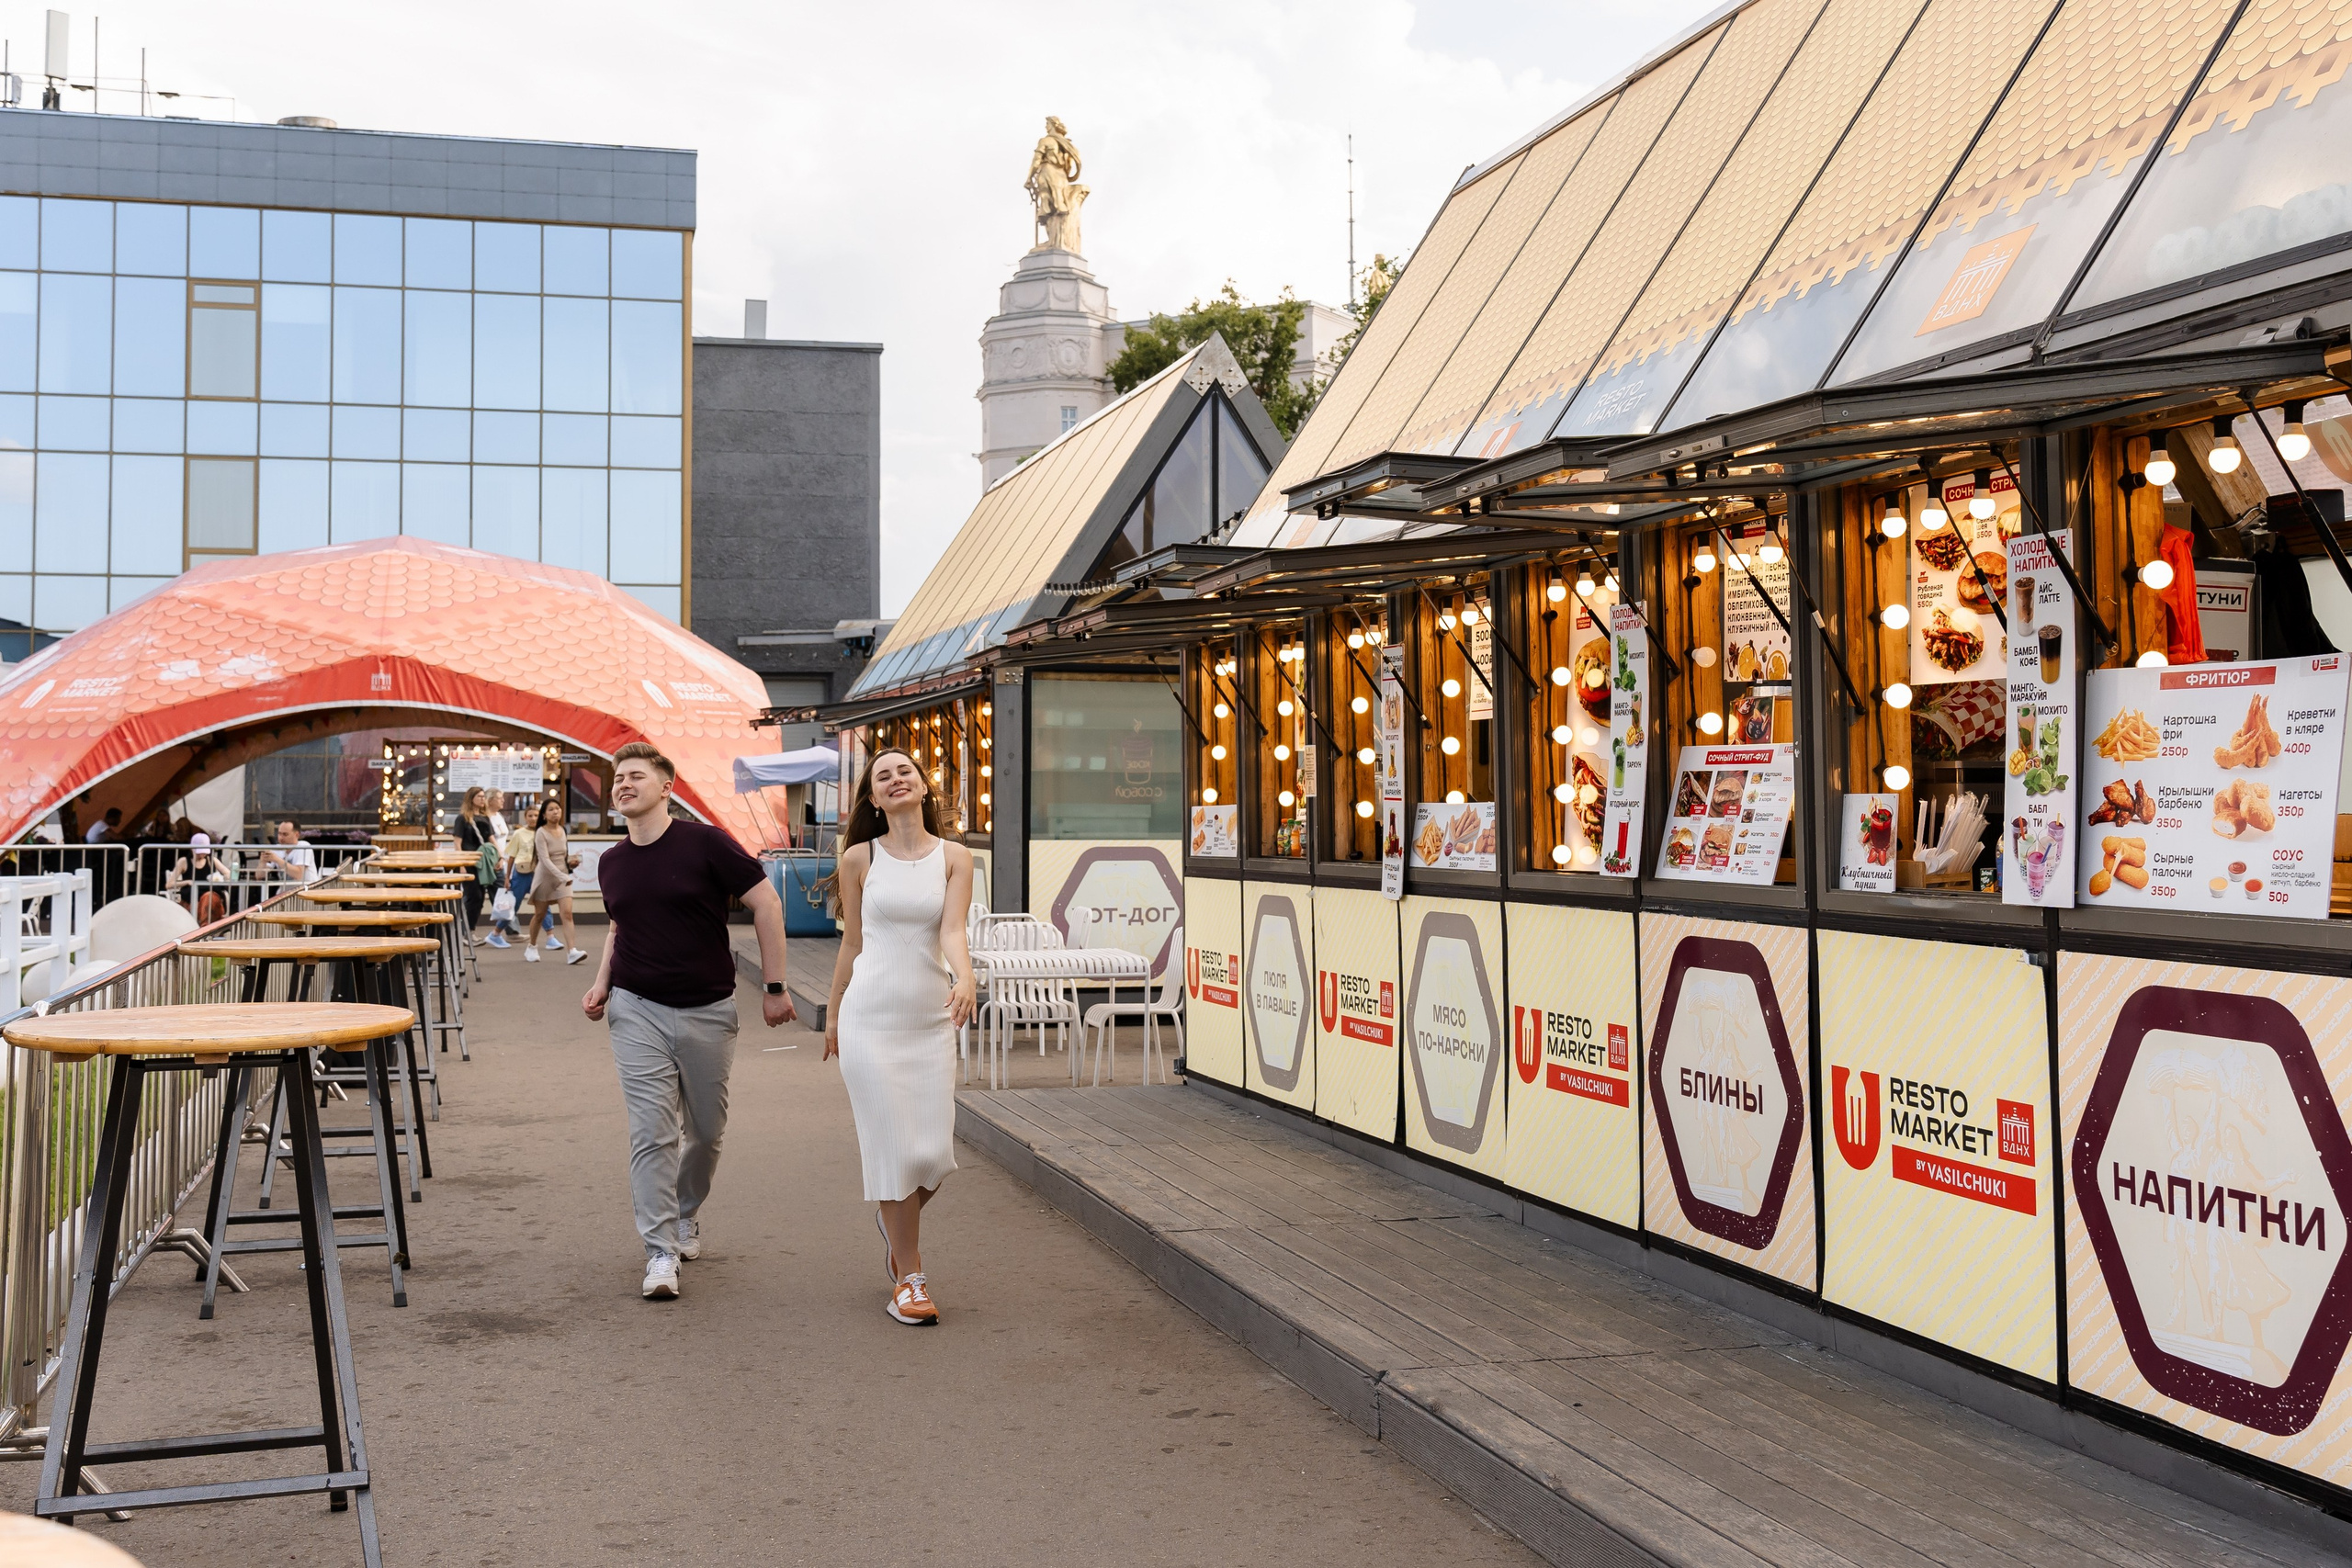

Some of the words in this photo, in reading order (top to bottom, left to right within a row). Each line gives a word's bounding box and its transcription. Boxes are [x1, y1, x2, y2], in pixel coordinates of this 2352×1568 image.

[1931, 290, 1987, 322] ВДНХ
[1593, 379, 1645, 410] RESTO
[1581, 393, 1646, 428] MARKET
[1949, 485, 1974, 500] СОЧН
[2010, 535, 2067, 558] ХОЛОДЕ
[1765, 561, 1790, 571] ЛЕСНЫ
[2014, 554, 2059, 573] НАПИТК
[2039, 581, 2053, 594] АЙС
[1775, 595, 1789, 606] ЧАЙ
[2038, 592, 2061, 604] ЛАТТЕ
[2197, 592, 2242, 605] ТУНИ
[1614, 619, 1642, 631] НАПИТКИ
[1771, 621, 1786, 631] ПУН
[2014, 646, 2038, 657] БАМБЛ
[2019, 657, 2038, 667] КОФЕ
[69, 677, 119, 688] RESTO
[2185, 671, 2251, 685] ФРИТЮР
[59, 686, 123, 698] MARKET
[668, 681, 715, 693] RESTO
[2010, 682, 2037, 694] МАНГО-
[676, 691, 732, 703] MARKET
[2010, 690, 2048, 703] МАРАКУЙЯ
[2038, 705, 2068, 716] МОХИТО
[2287, 707, 2336, 721] Креветки
[2163, 715, 2217, 726] Картошка
[2162, 728, 2183, 741] фри
[2286, 727, 2291, 735] в
[2294, 723, 2324, 736] кляре
[2161, 746, 2188, 758] 250р
[2284, 743, 2312, 756] 400р
[1708, 752, 1733, 762] СОЧНЫЙ
[1734, 752, 1770, 762] СТРИТ-ФУД
[2158, 785, 2215, 797] Крылышки
[2278, 789, 2323, 801] Нагетсы
[2028, 804, 2048, 814] БАБЛ
[2157, 797, 2203, 811] барбекю
[2278, 806, 2304, 818] 350р
[2033, 818, 2042, 828] ТИ
[2156, 818, 2183, 829] 350р
[2153, 852, 2194, 866] Сырные
[2272, 849, 2304, 861] СОУС
[1840, 864, 1894, 881] Клубничный
[2152, 867, 2193, 878] палочки
[1854, 880, 1878, 891] пунш
[2150, 886, 2177, 898] 350р
[2268, 891, 2289, 904] 50р
[1072, 907, 1176, 926] ОТ-ДОГ
[1201, 949, 1222, 965] RESTO
[1201, 965, 1228, 984] MARKET
[1263, 970, 1287, 989] ЛЮЛЯ
[1340, 974, 1370, 995] RESTO
[1256, 993, 1261, 1009] В
[1262, 994, 1297, 1017] ЛАВАШЕ
[1340, 992, 1379, 1016] MARKET
[1432, 1003, 1466, 1028] МЯСО
[1353, 1022, 1384, 1040] VASILCHUKI
[1547, 1011, 1592, 1039] RESTO
[1419, 1030, 1485, 1064] ПО-КАРСКИ
[1546, 1034, 1606, 1066] MARKET
[1611, 1054, 1626, 1066] ВДНХ
[1559, 1072, 1566, 1082] BY
[1566, 1074, 1613, 1098] VASILCHUKI
[1679, 1066, 1764, 1115] БЛИНЫ
[1890, 1077, 1969, 1118] RESTO
[1891, 1108, 1994, 1156] MARKET
[2002, 1140, 2030, 1157] ВДНХ
[1916, 1158, 1927, 1172] BY
[1927, 1161, 2007, 1199] VASILCHUKI
[2112, 1160, 2326, 1252] НАПИТКИ
